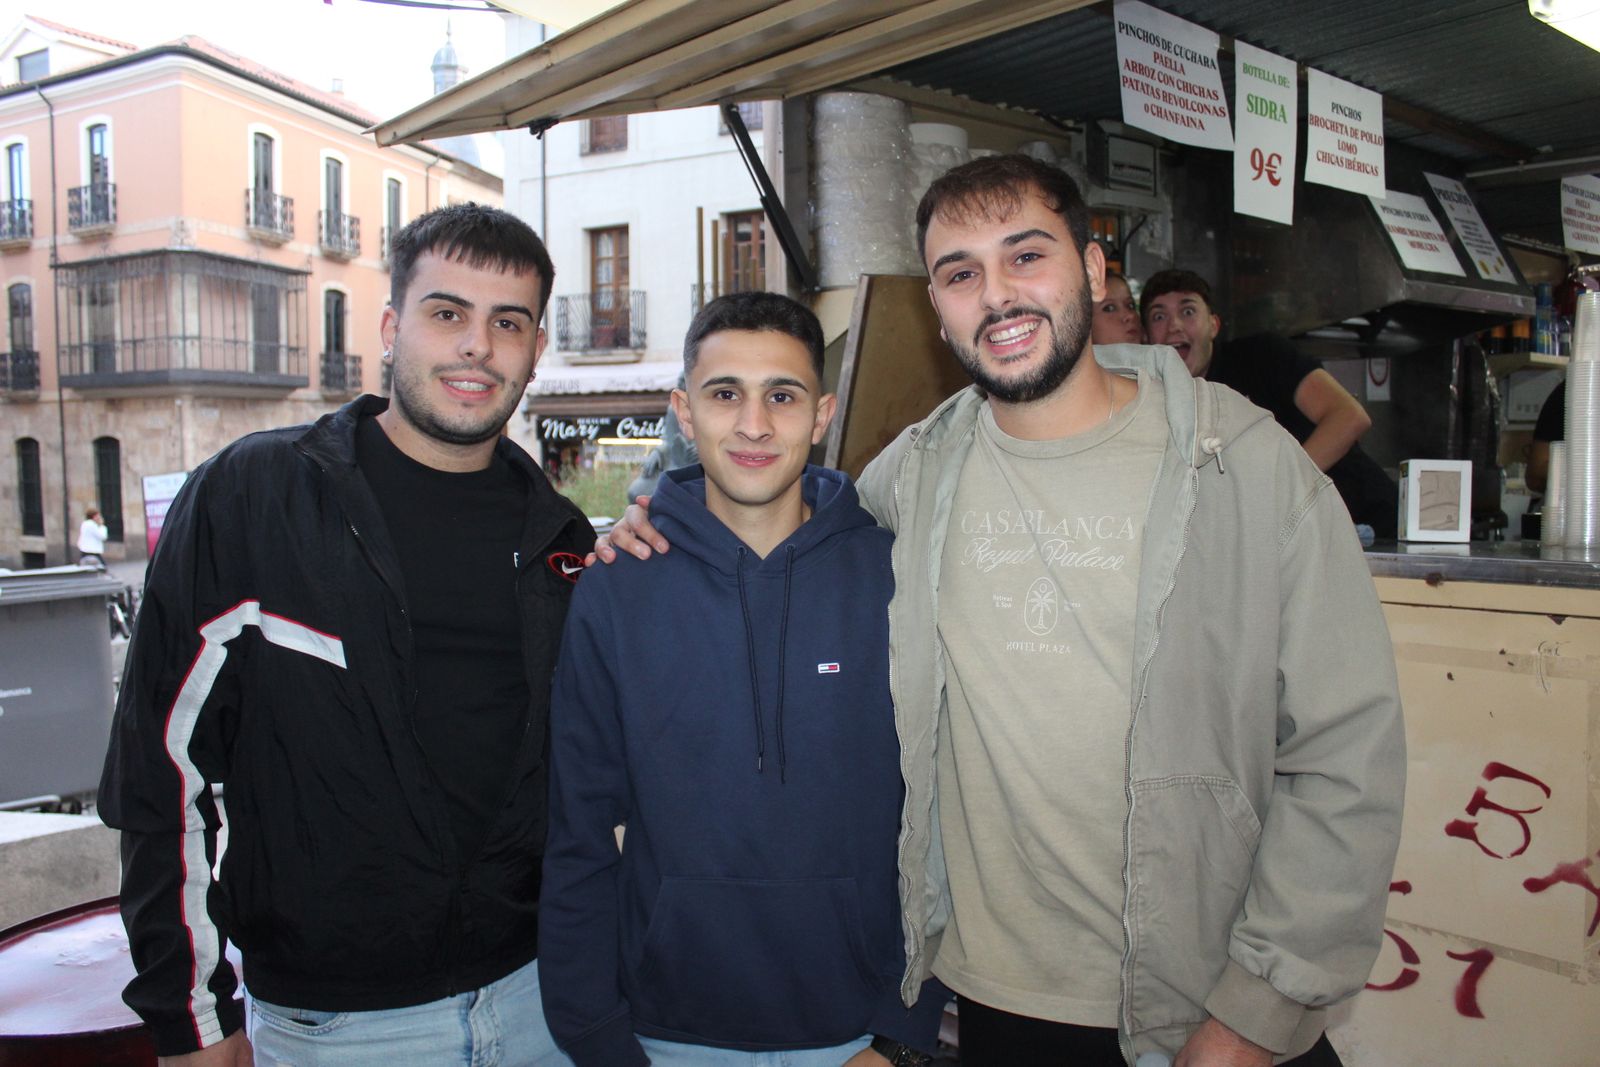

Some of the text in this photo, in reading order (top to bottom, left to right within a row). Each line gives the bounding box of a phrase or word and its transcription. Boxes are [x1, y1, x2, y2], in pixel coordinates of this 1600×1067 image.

[1118, 21, 1217, 70] PINCHOS DE CUCHARA
[1153, 51, 1186, 75] PAELLA
[1242, 62, 1277, 85] BOTELLA
[1123, 58, 1219, 101] ARROZ CON CHICHAS
[1122, 75, 1226, 118] PATATAS REVOLCONAS
[1246, 93, 1288, 124] SIDRA
[1150, 103, 1205, 131] CHANFAINA
[1331, 101, 1362, 122] PINCHOS
[1308, 114, 1384, 147] BROCHETA DE POLLO
[1337, 139, 1358, 155] LOMO
[1250, 147, 1282, 187] 9€
[1316, 150, 1379, 177] CHICAS IBÉRICAS
[542, 418, 599, 440] Mary
[961, 510, 1136, 540] CASABLANCA
[961, 537, 1125, 573] Royal Palace
[1006, 641, 1072, 655] HOTEL PLAZA
